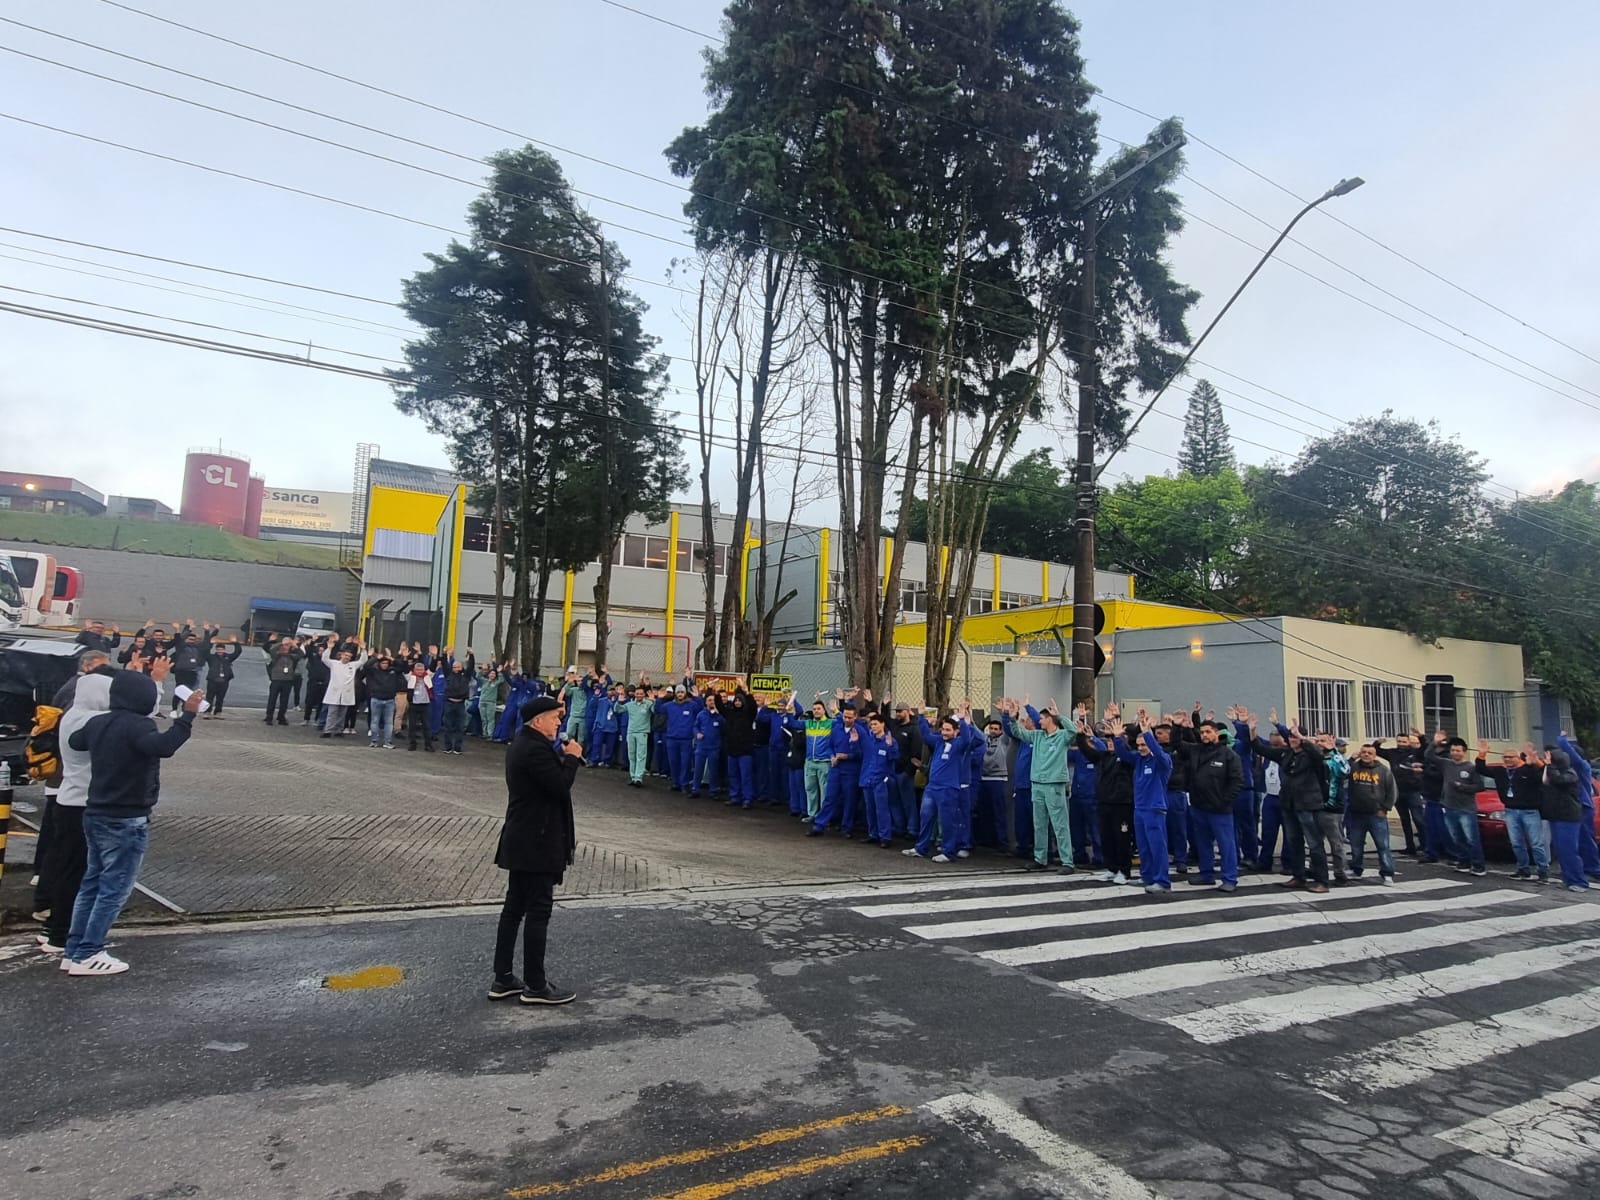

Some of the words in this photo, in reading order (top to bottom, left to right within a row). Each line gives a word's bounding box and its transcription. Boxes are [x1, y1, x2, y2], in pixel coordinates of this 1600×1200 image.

[203, 464, 238, 488] CL
[272, 490, 319, 504] sanca
[695, 678, 741, 692] PRBID
